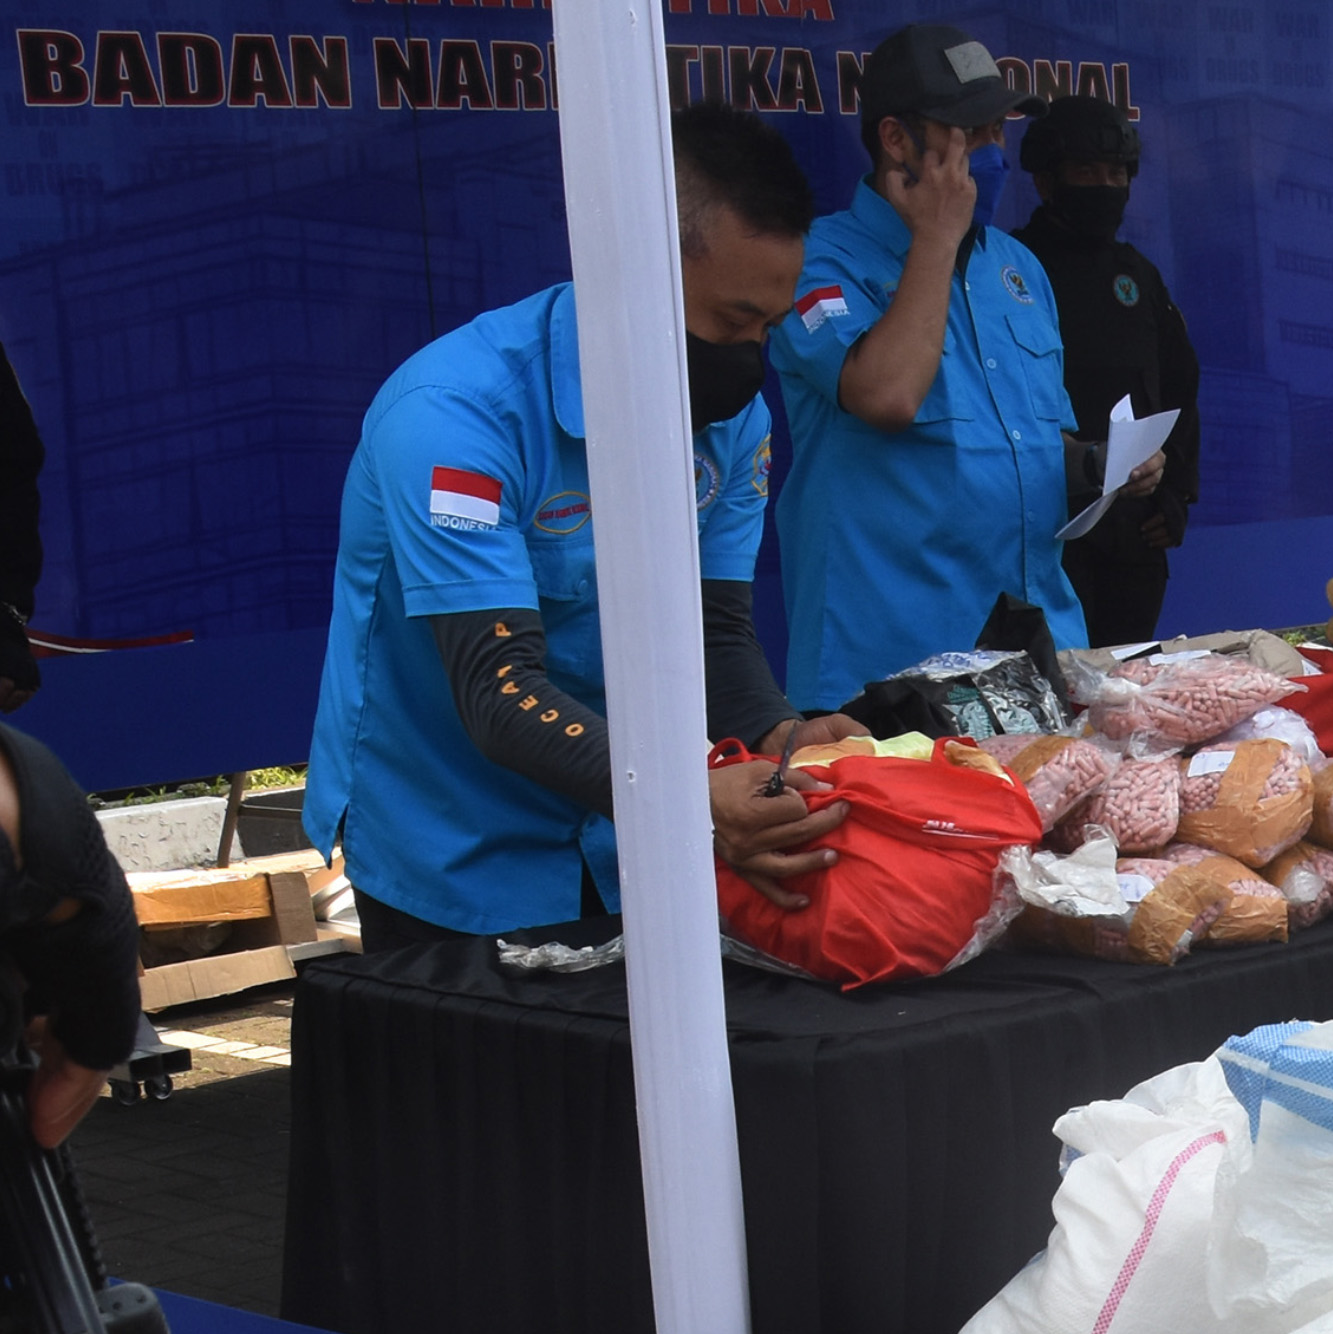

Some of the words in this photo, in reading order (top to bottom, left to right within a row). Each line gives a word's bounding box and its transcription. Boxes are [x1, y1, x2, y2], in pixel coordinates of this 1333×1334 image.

[16, 28, 353, 110] BADAN
[372, 37, 824, 114] NARTIKA
[836, 50, 1140, 122] NONAL
